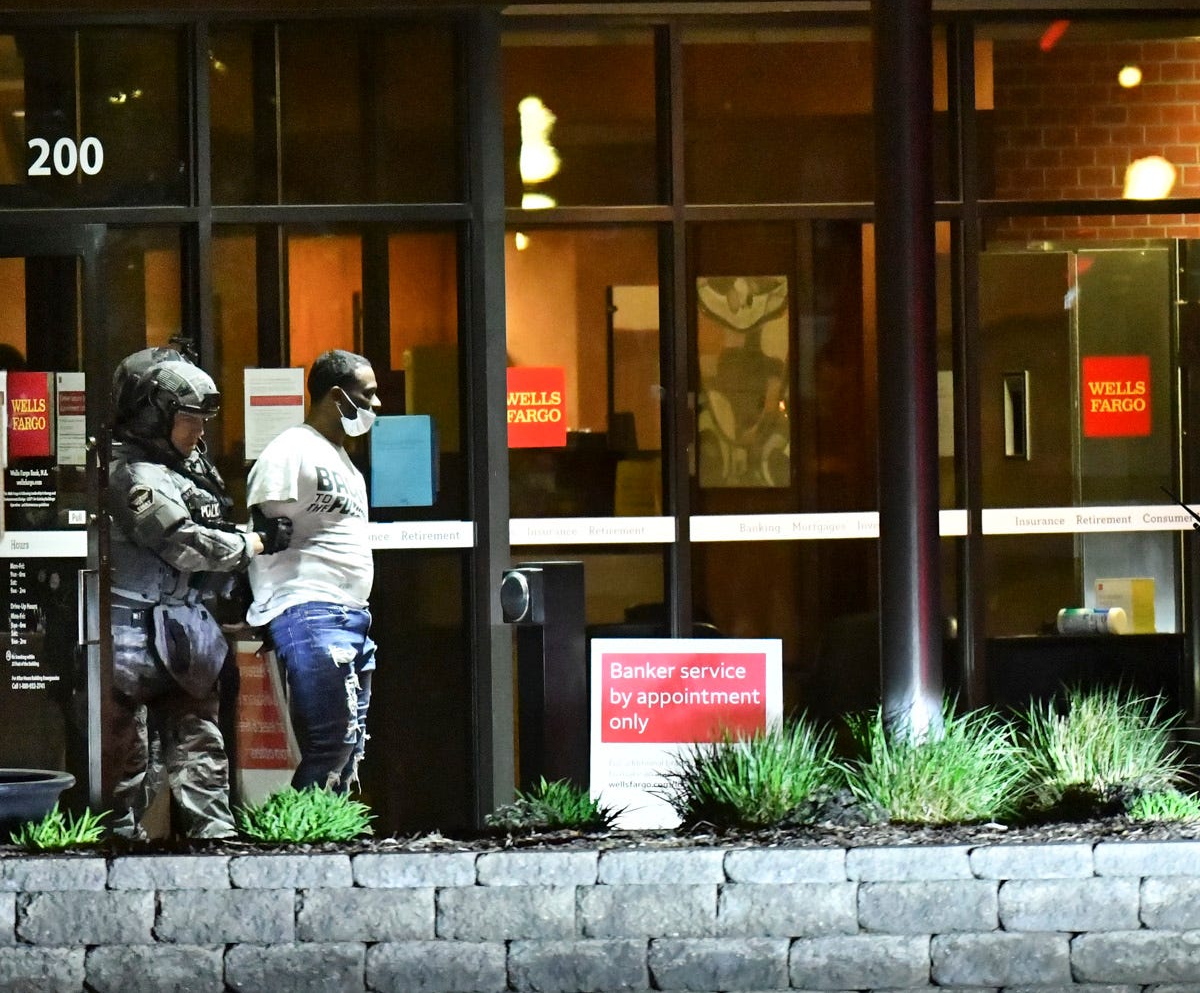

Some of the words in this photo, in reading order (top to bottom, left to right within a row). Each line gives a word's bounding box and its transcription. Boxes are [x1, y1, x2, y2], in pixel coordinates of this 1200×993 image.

[27, 136, 104, 176] 200
[1087, 380, 1146, 396] WELLS
[11, 398, 46, 413] WELLS
[506, 391, 562, 406] WELLS
[1090, 397, 1147, 412] FARGO
[506, 408, 562, 423] FARGO
[12, 416, 46, 431] FARGO
[315, 493, 333, 504] TO
[739, 522, 781, 534] Banking
[792, 521, 846, 534] Mortgages
[1015, 516, 1065, 527] Insurance
[1075, 514, 1132, 525] Retirement
[1142, 513, 1194, 524] Consumer
[401, 531, 460, 542] Retirement
[589, 525, 647, 536] Retirement
[10, 539, 30, 550] Hours
[609, 661, 676, 679] Banker
[680, 661, 747, 680] service
[609, 687, 633, 709] by
[636, 687, 761, 709] appointment
[609, 713, 650, 735] only
